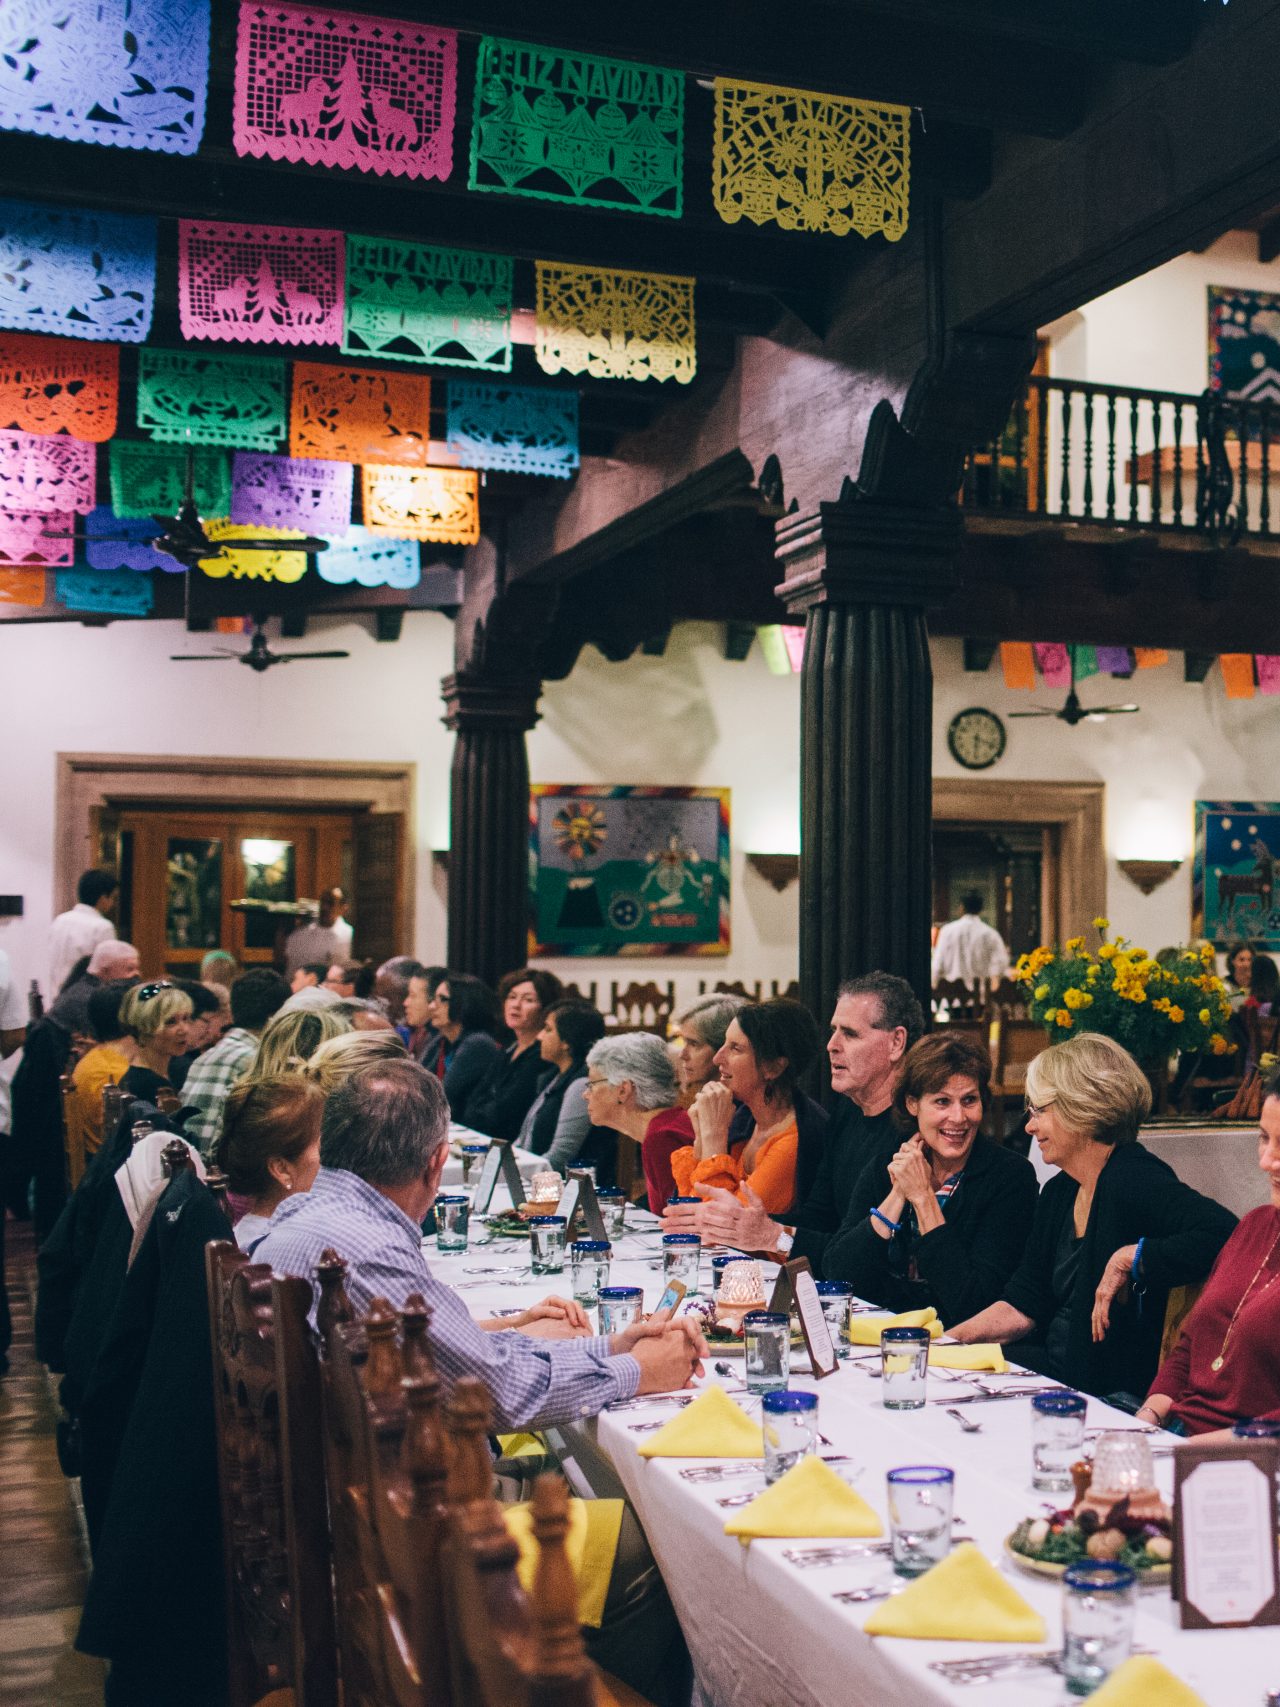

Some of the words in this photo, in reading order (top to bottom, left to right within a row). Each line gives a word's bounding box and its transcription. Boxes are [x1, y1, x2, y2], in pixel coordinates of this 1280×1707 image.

[486, 46, 556, 87] FELIZ
[561, 58, 678, 107] NAVIDAD
[722, 103, 794, 172] FELIZ
[797, 97, 899, 178] NAVIDAD
[353, 245, 411, 274] FELIZ
[415, 250, 509, 286] NAVIDAD
